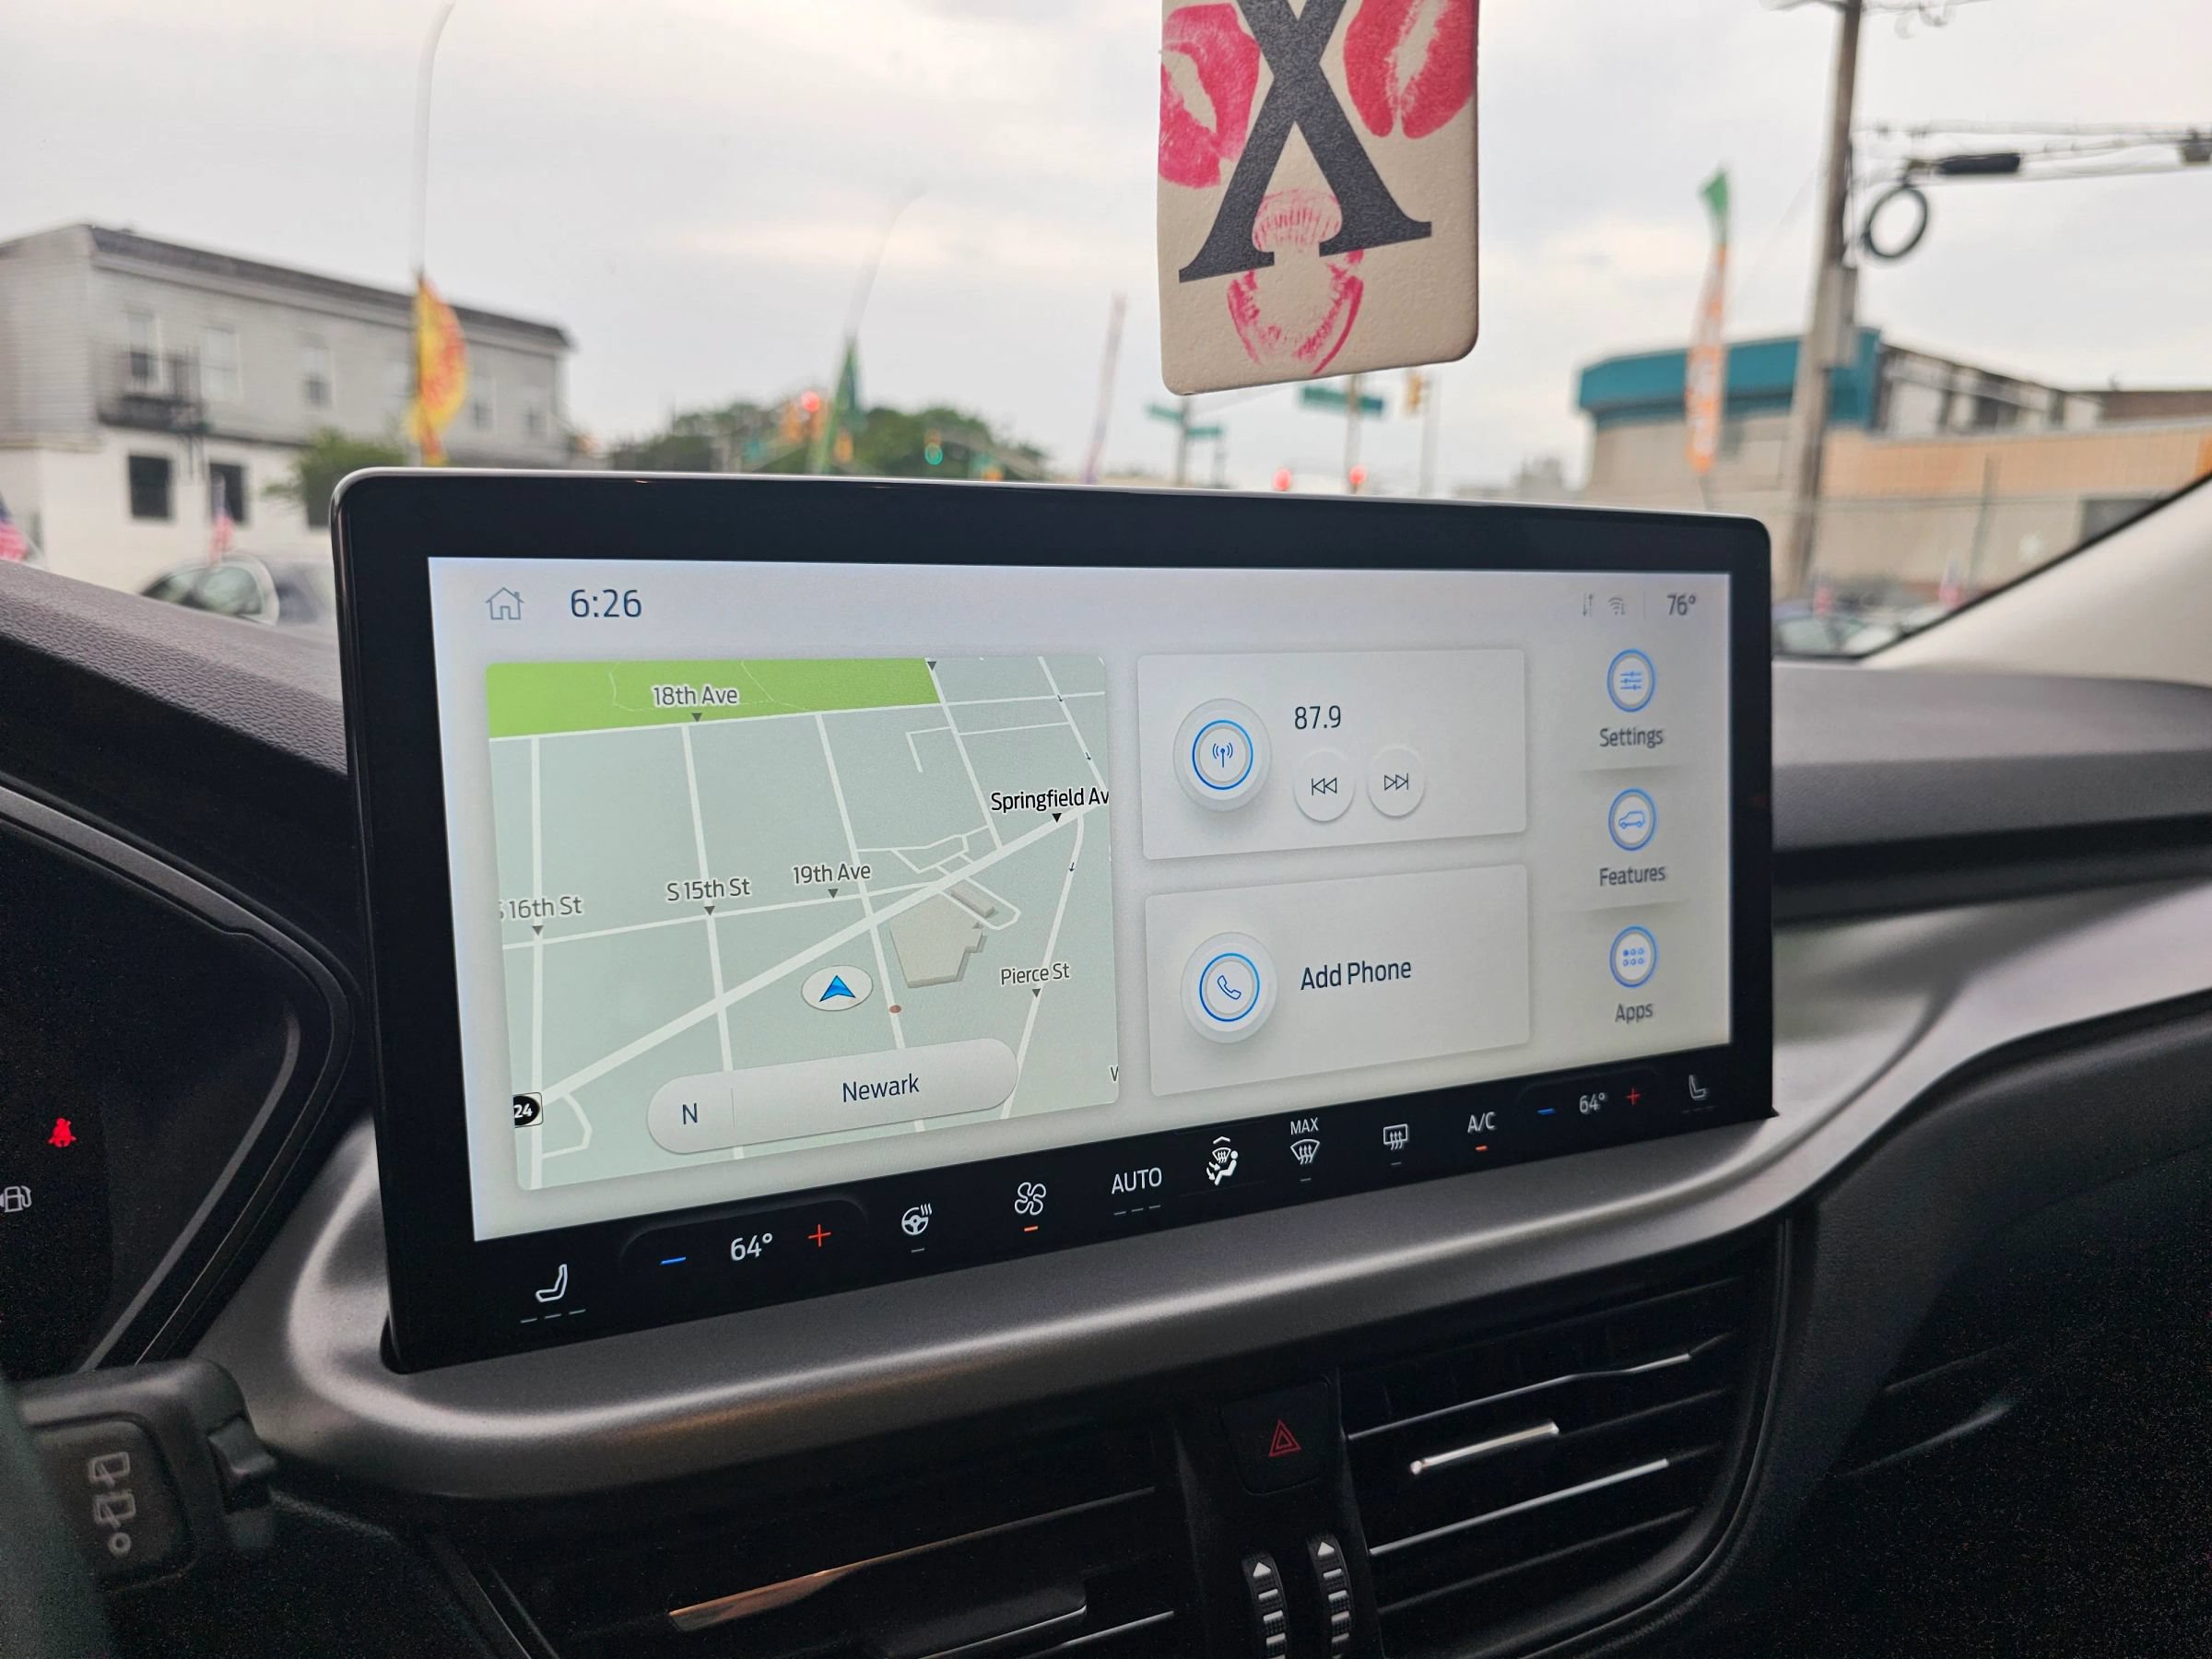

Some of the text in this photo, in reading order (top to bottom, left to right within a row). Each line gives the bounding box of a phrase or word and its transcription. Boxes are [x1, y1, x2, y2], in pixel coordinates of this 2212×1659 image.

[1179, 0, 1432, 284] X
[570, 588, 643, 618] 6:26
[1666, 594, 1697, 617] 76°
[653, 685, 738, 706] 18th Ave
[1293, 705, 1342, 731] 87.9
[1599, 726, 1665, 750] Settings
[991, 786, 1110, 814] Springfield Av
[792, 862, 872, 885] 19th Ave
[1599, 865, 1667, 888] Features
[665, 876, 751, 902] S 15th St
[508, 897, 555, 920] 16th
[559, 895, 583, 916] St
[1000, 962, 1071, 986] Pierce St
[1300, 959, 1413, 991] Add Phone
[1614, 1002, 1654, 1025] Apps
[841, 1072, 921, 1104] Newark
[681, 1101, 699, 1125] N
[1578, 1091, 1606, 1114] 64°
[1289, 1116, 1320, 1136] MAX
[1467, 1110, 1497, 1134] A/C
[1110, 1166, 1163, 1195] AUTO
[729, 1231, 774, 1262] 64°
